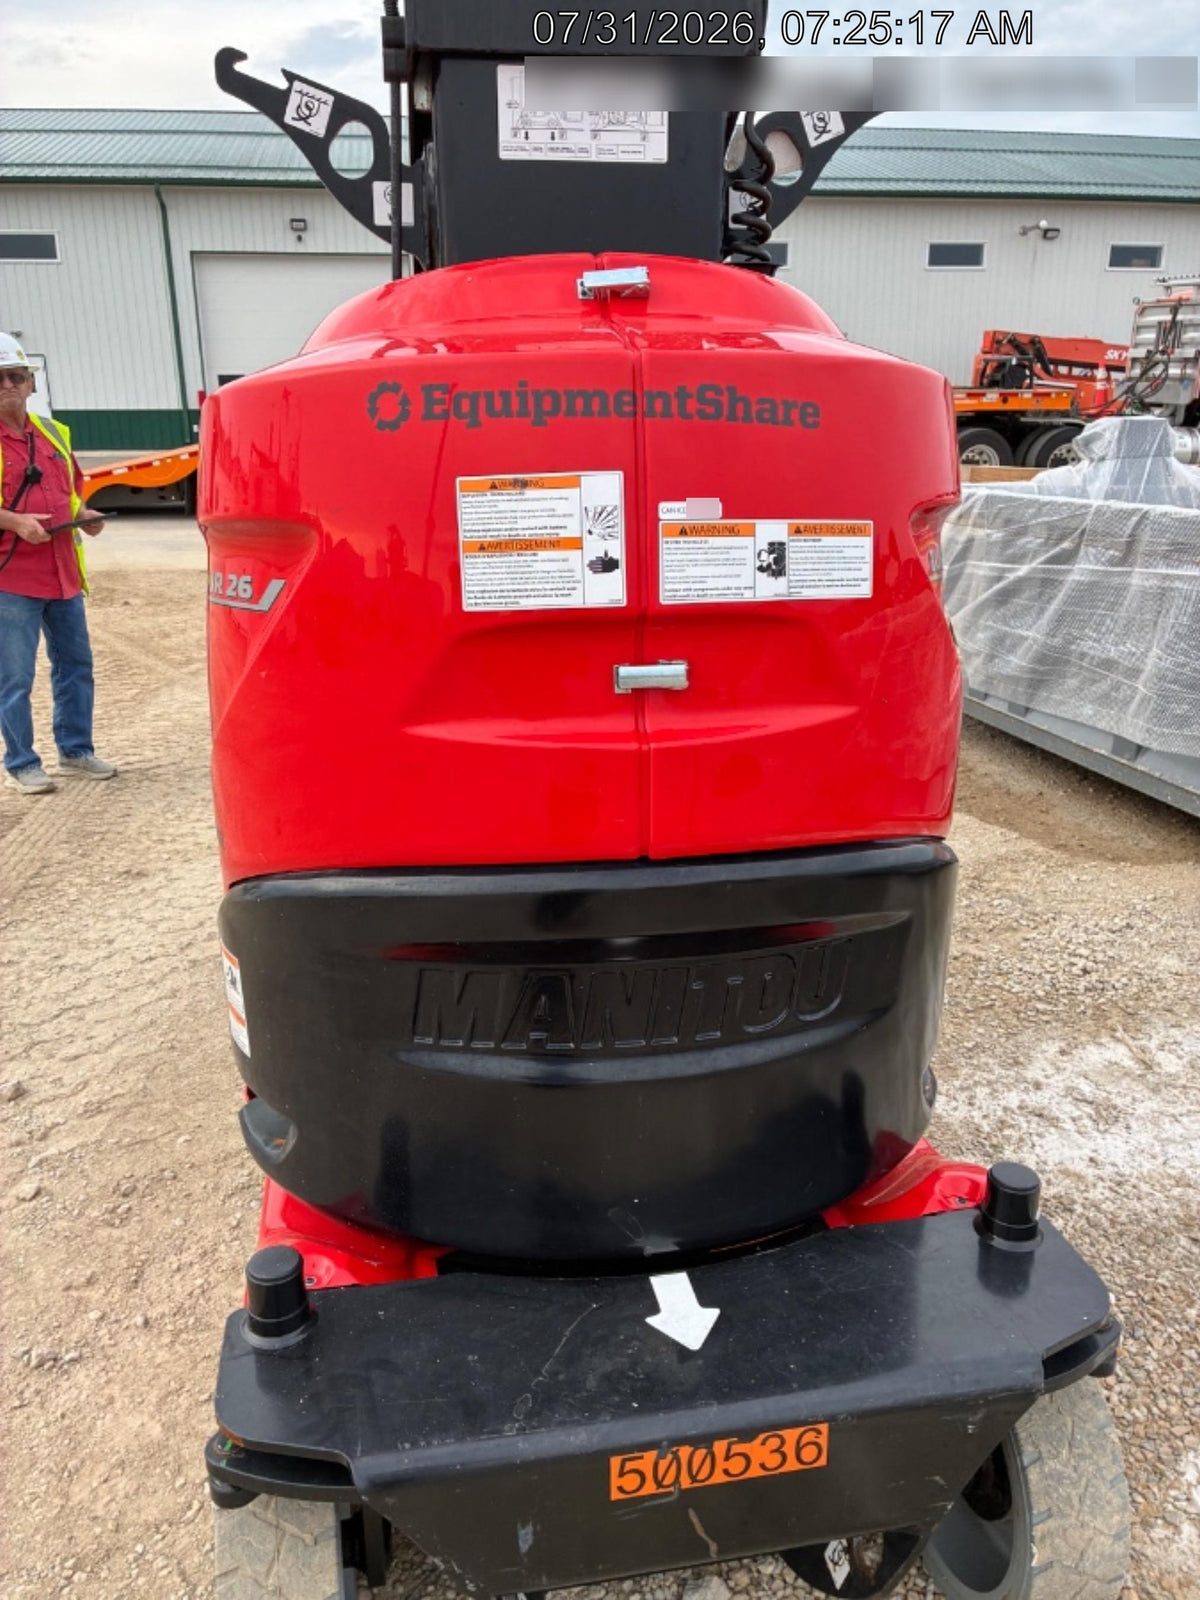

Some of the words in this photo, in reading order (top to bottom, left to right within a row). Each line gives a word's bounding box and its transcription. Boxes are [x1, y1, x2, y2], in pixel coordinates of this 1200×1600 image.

[421, 380, 821, 430] EquipmentShare
[689, 525, 741, 535] WARNING
[803, 525, 867, 535] AVERTISSEMENT
[486, 540, 561, 551] AVERTISSEMENT
[226, 573, 253, 600] 26
[412, 938, 850, 1049] MANITOU
[616, 1427, 823, 1496] 500536
